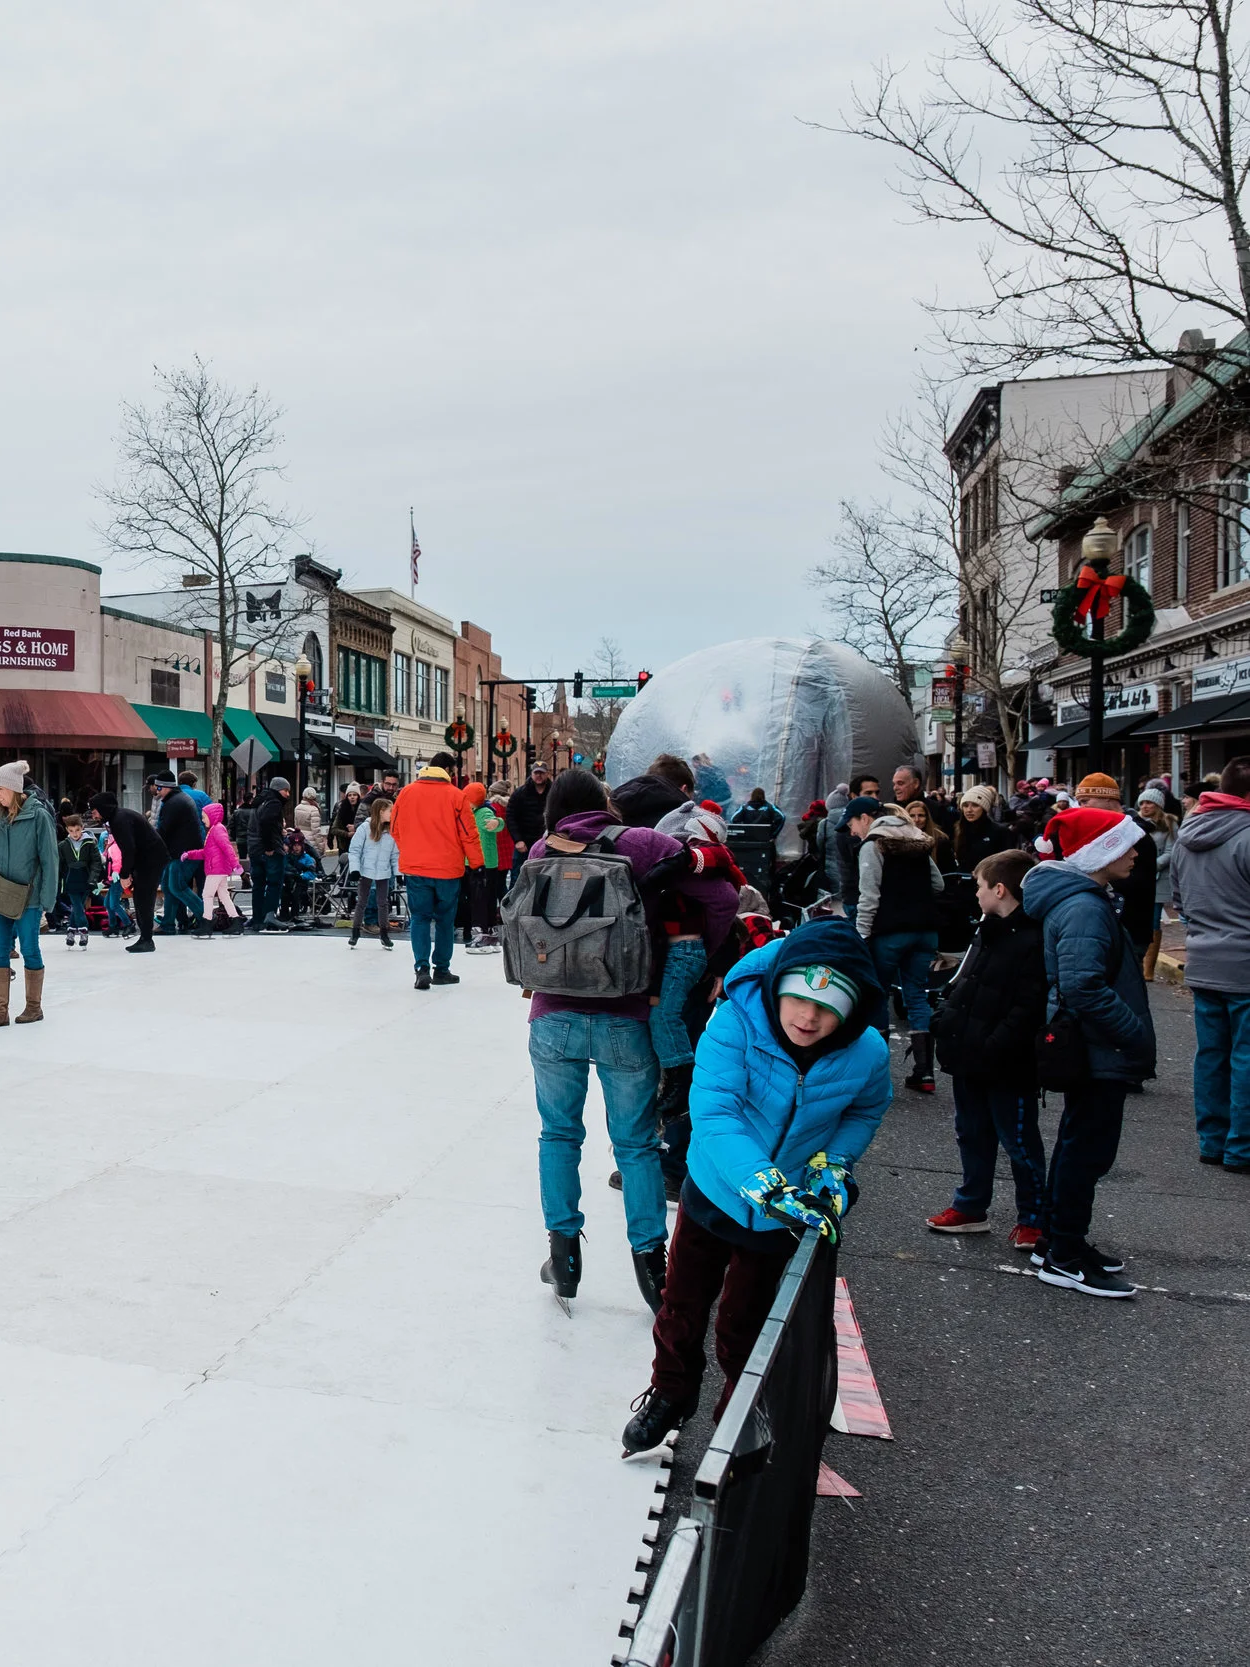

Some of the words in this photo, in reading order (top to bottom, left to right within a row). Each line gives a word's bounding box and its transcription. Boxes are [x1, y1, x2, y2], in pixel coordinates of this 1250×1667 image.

[3, 629, 20, 637] Red
[21, 629, 42, 638] Bank
[15, 640, 27, 654] &
[31, 641, 68, 656] HOME
